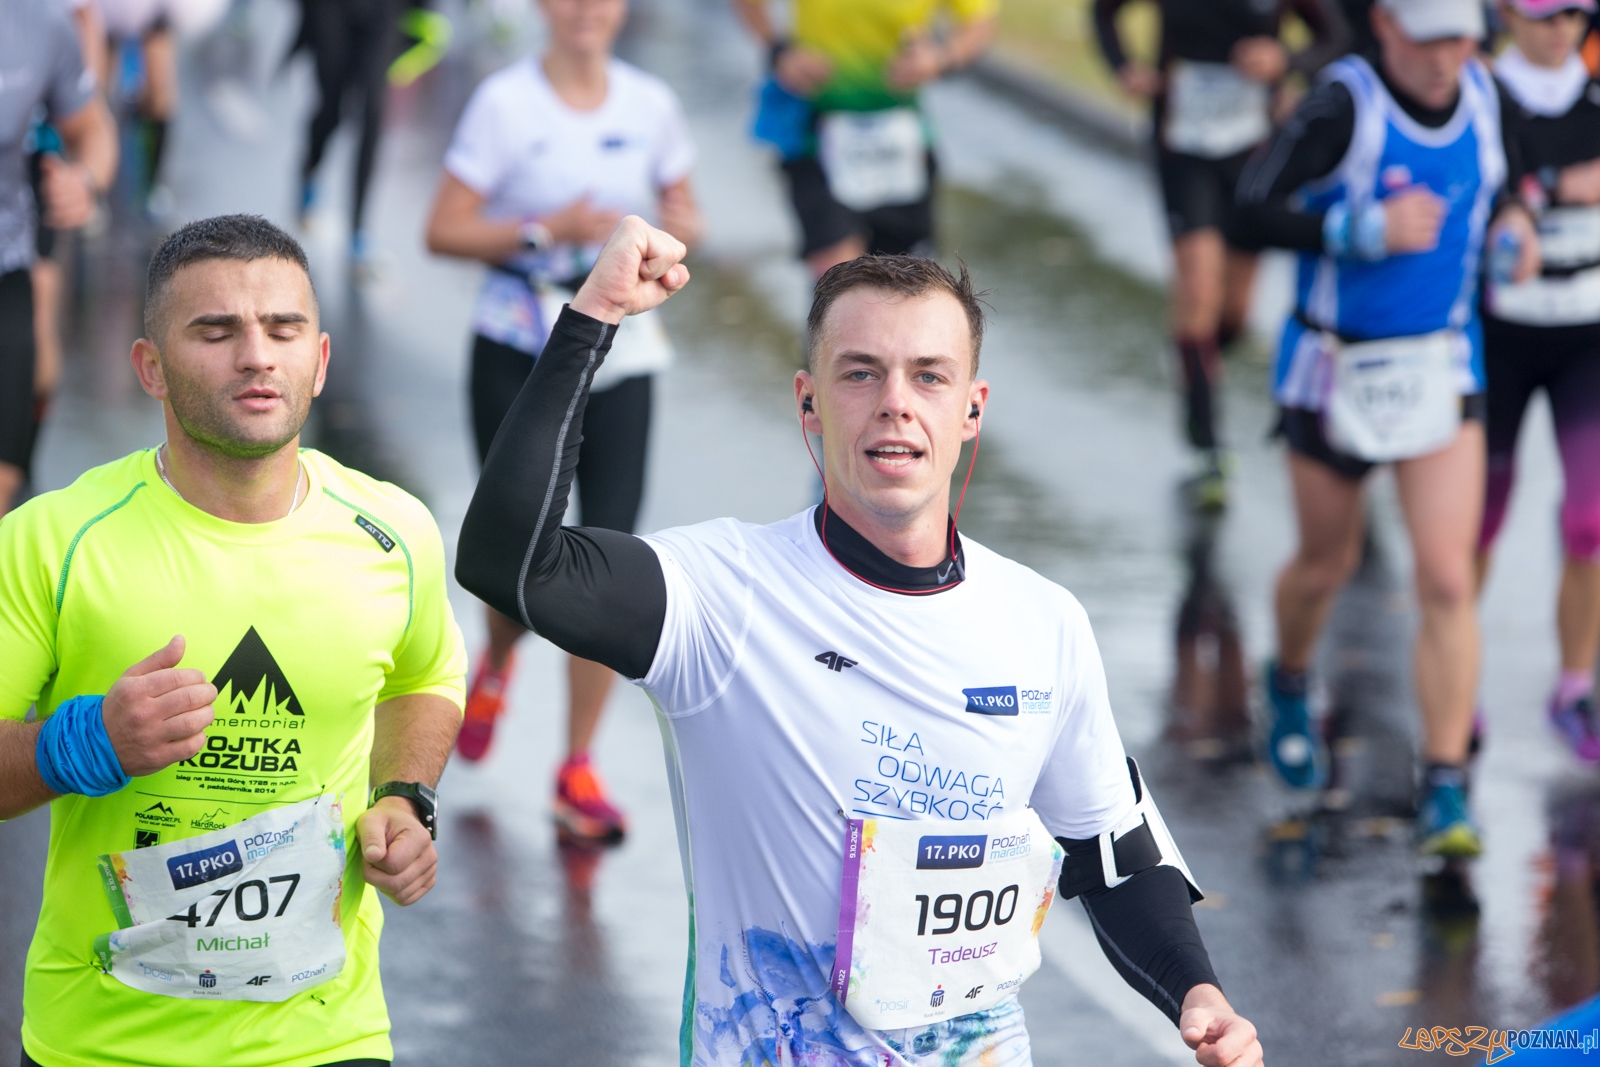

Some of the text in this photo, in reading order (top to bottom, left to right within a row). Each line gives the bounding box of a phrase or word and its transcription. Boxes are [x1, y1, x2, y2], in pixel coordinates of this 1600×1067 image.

[206, 735, 302, 755] OJTKA
[861, 720, 925, 756] SIŁA
[877, 755, 1005, 799] ODWAGA
[990, 844, 1031, 859] maraton
[915, 884, 1019, 936] 1900
[197, 932, 271, 951] Michał
[928, 942, 998, 965] Tadeusz
